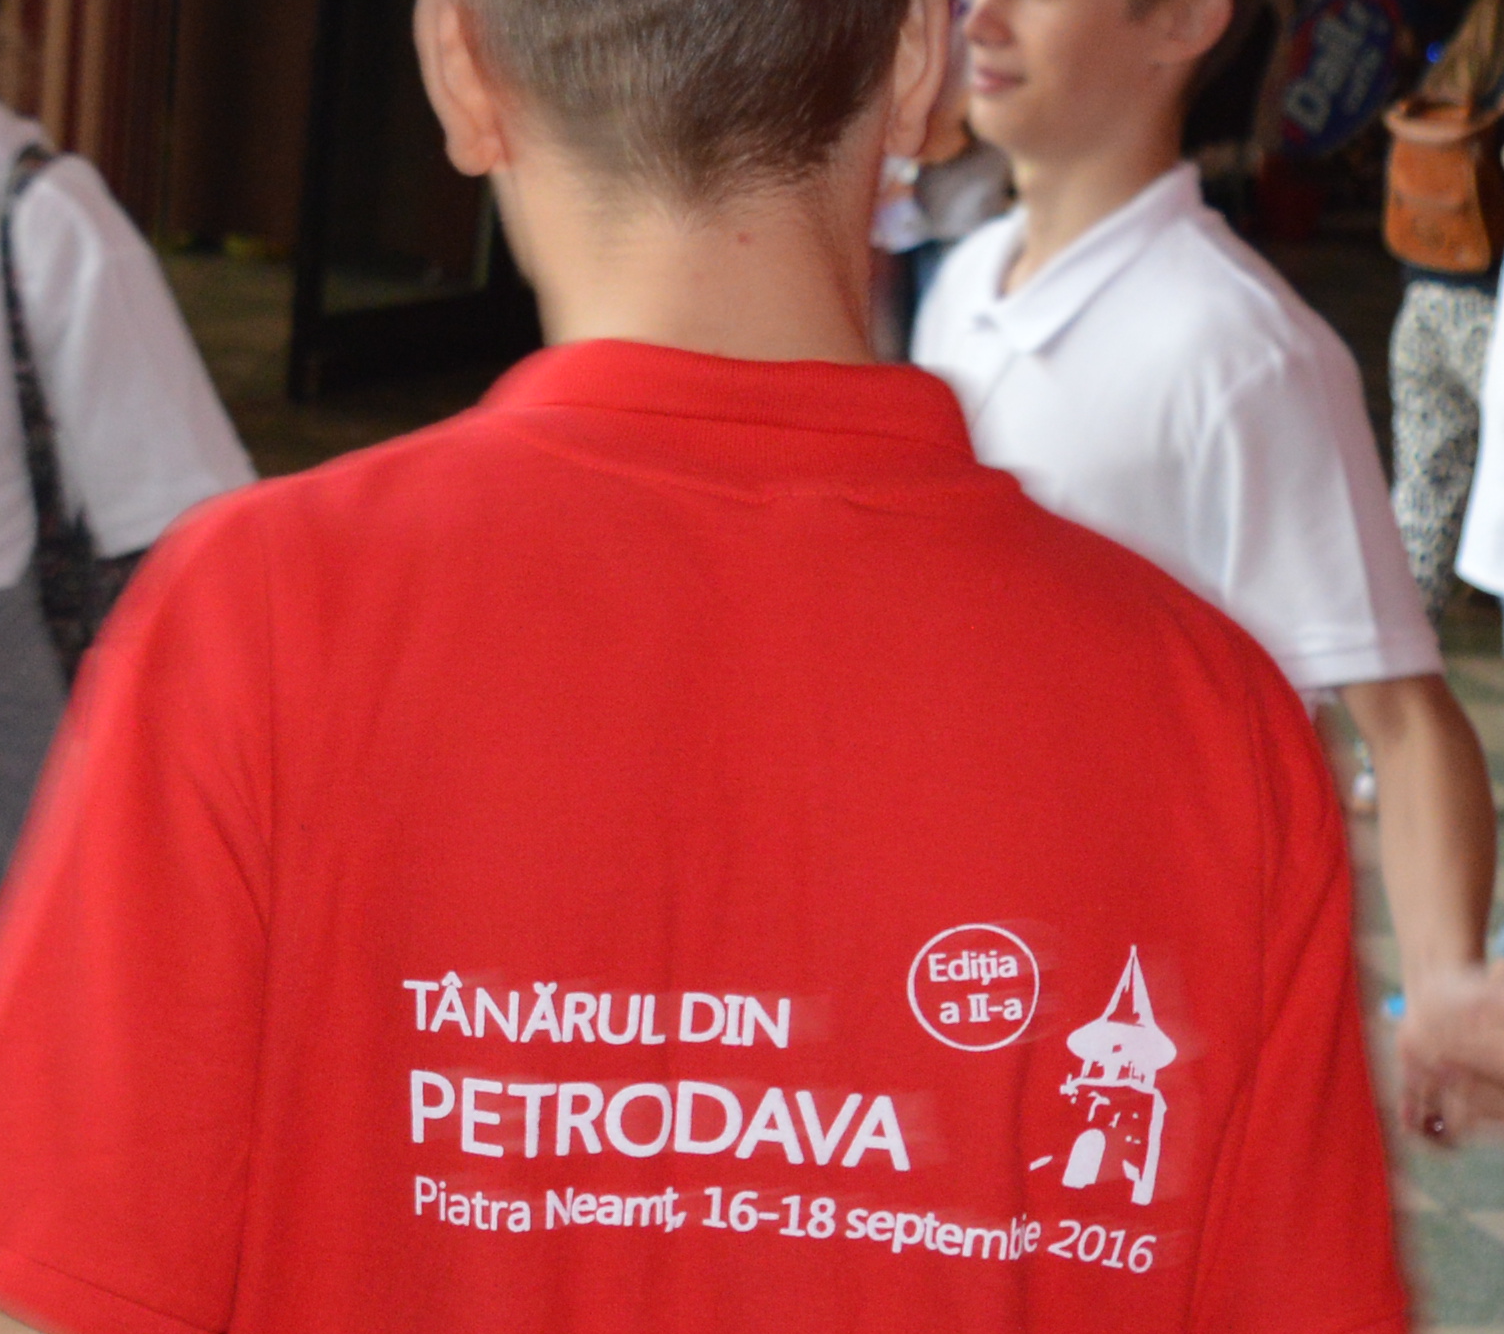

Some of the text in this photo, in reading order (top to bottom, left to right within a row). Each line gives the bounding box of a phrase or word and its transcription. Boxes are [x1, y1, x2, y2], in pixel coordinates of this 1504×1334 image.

[403, 970, 791, 1049] TÂNĂRUL DIN
[939, 993, 1023, 1025] a II-a
[410, 1069, 911, 1172] PETRODAVA
[414, 1175, 531, 1232] Piatra
[1047, 1219, 1157, 1274] 2016
